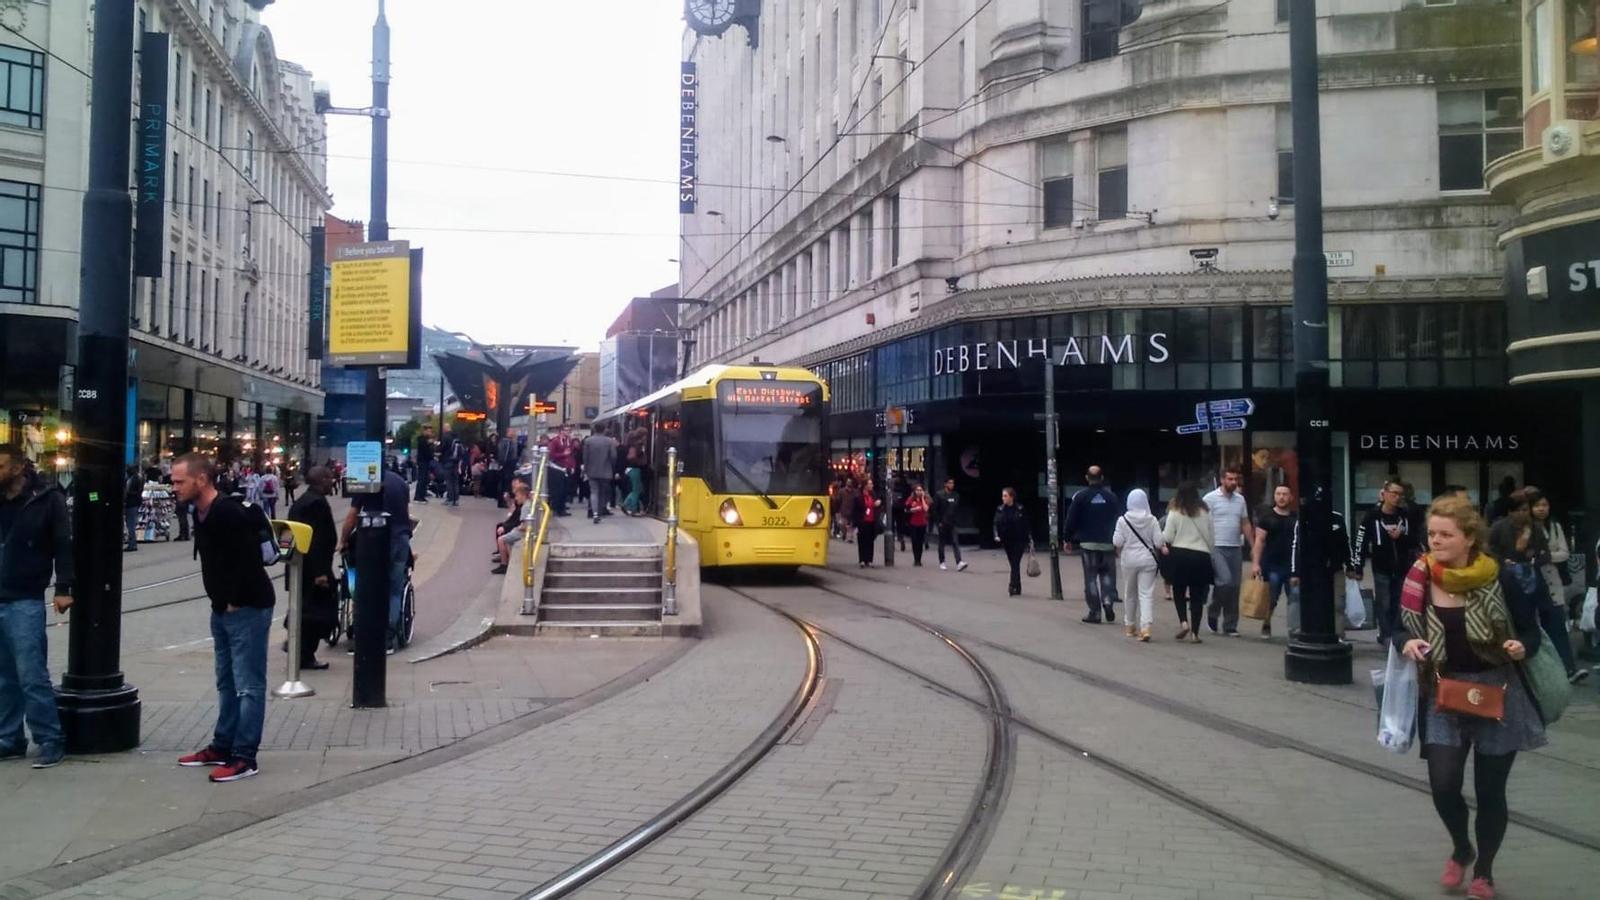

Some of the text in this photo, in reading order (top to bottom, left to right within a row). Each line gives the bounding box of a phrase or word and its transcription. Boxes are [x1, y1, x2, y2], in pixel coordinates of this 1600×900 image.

[144, 104, 161, 203] PRIMARK
[681, 73, 695, 202] DEBENHAMS
[934, 333, 1169, 376] DEBENHAMS
[736, 387, 758, 395] East
[1360, 434, 1520, 449] DEBENHAMS
